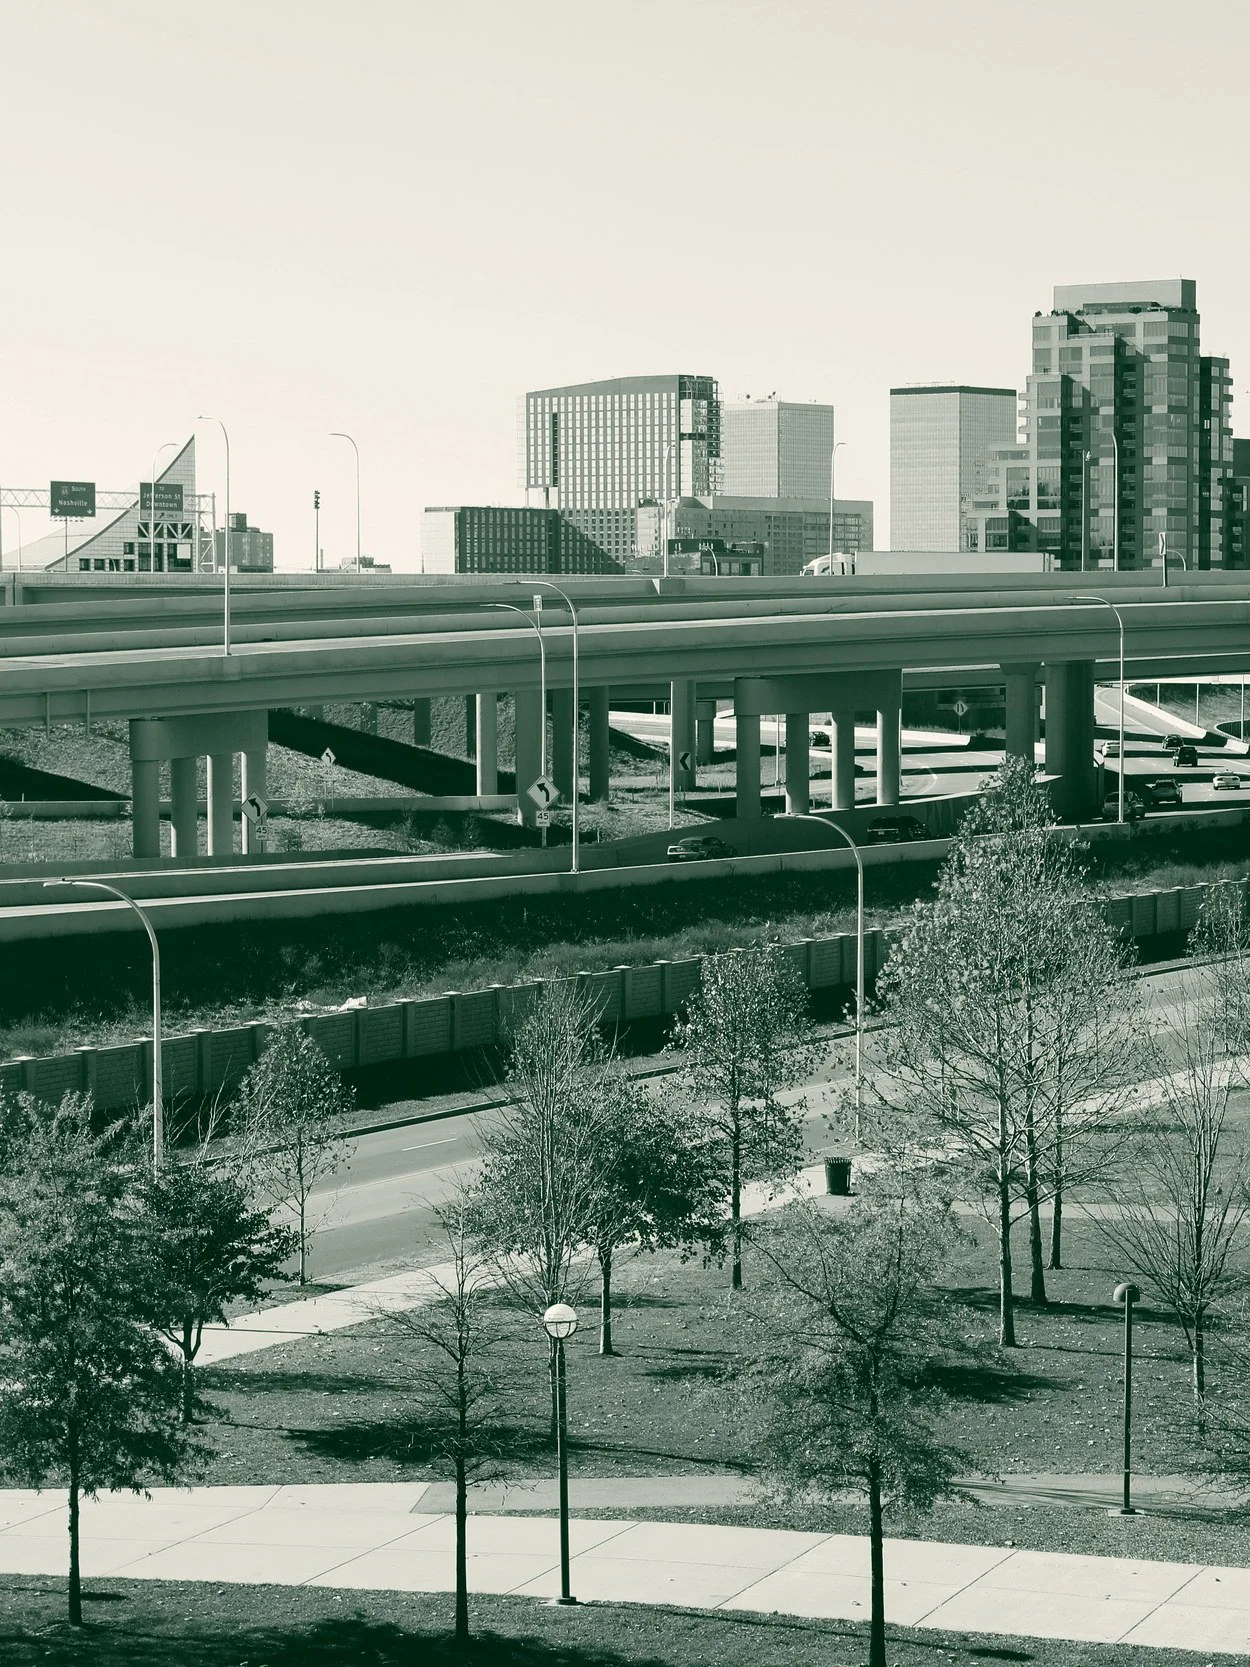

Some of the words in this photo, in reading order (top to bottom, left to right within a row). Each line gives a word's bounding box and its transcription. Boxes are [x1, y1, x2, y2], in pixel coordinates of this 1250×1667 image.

[143, 492, 172, 500] Jeerson
[58, 499, 88, 507] Nashville
[537, 812, 549, 820] 45
[256, 826, 267, 834] 45
